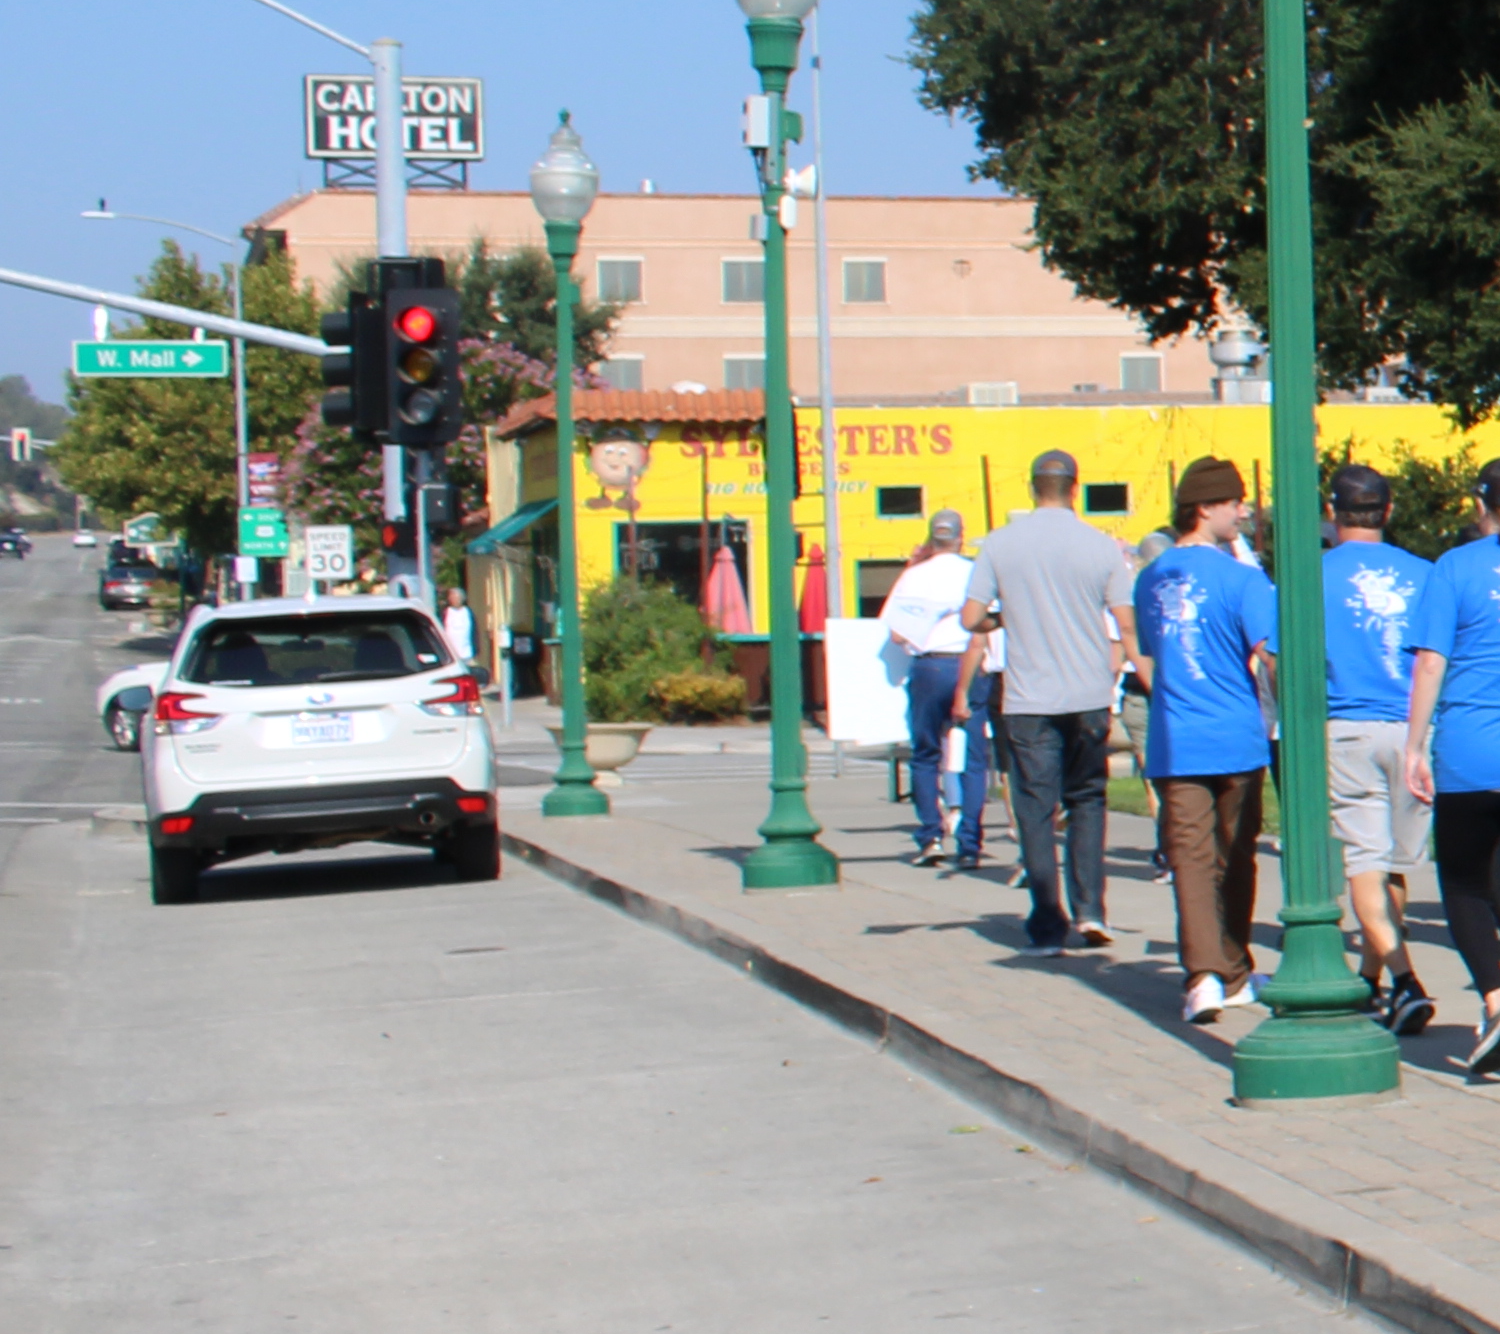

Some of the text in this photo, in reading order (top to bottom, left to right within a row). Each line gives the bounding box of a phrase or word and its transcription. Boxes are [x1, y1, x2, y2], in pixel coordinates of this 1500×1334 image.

[97, 349, 175, 367] W. Mall
[309, 532, 347, 540] SPEED
[313, 542, 344, 551] LIMIT
[310, 553, 346, 573] 30
